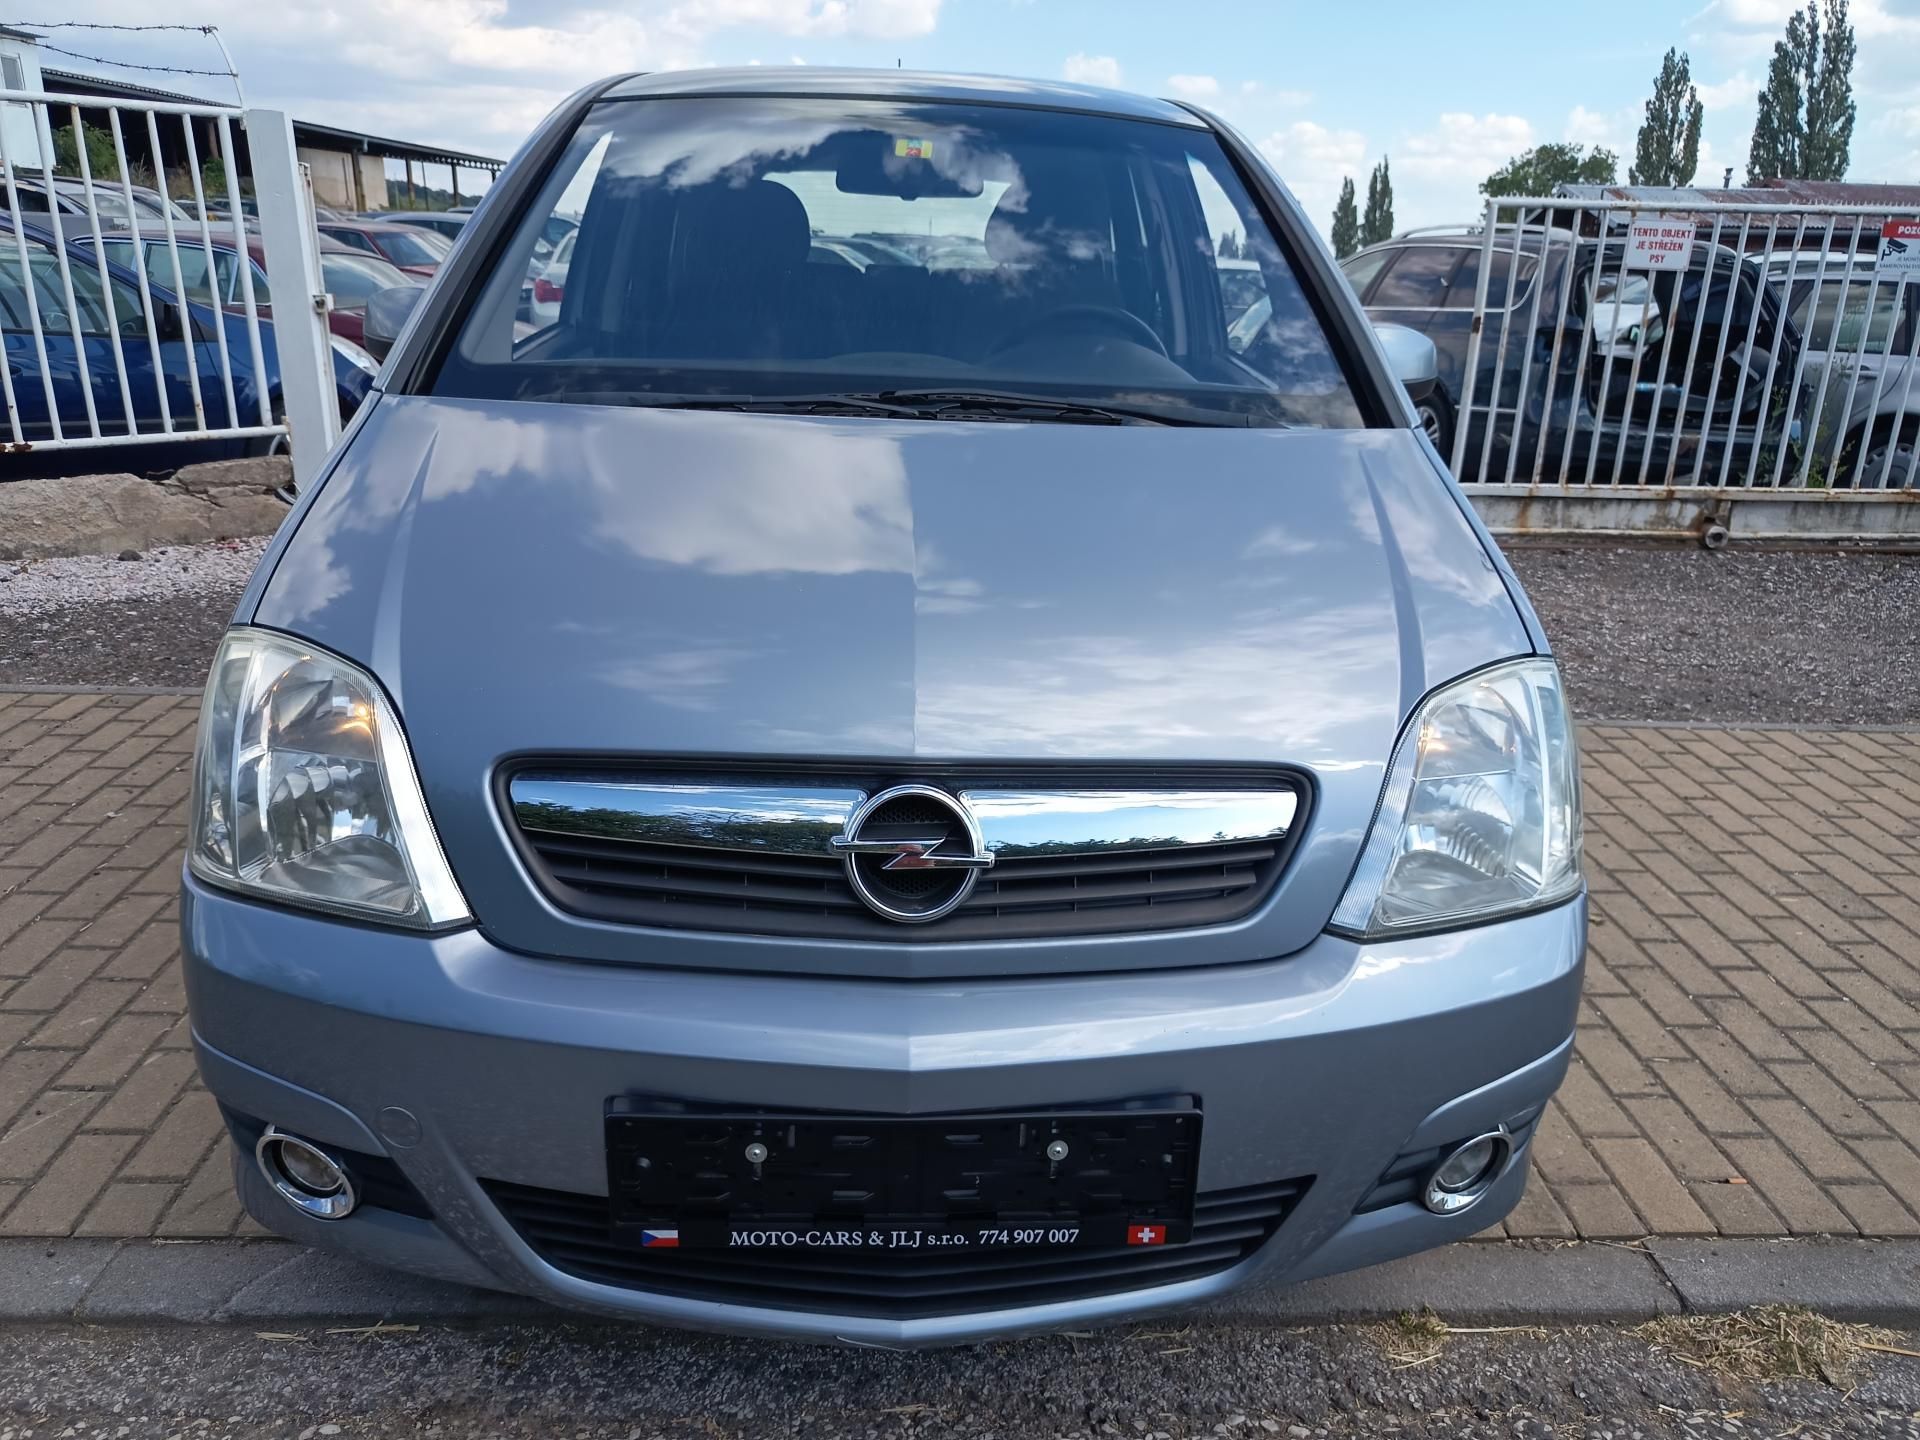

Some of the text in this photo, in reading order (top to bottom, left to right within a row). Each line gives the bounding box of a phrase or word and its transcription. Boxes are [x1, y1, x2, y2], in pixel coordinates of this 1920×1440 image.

[1633, 228, 1692, 239] TENTO OBJEKT
[1636, 239, 1683, 251] JE STŘEŽEN
[1649, 254, 1665, 263] PSY
[729, 1229, 1079, 1248] MOTO-CARS & JLJ s.r.o. 774 907 007
